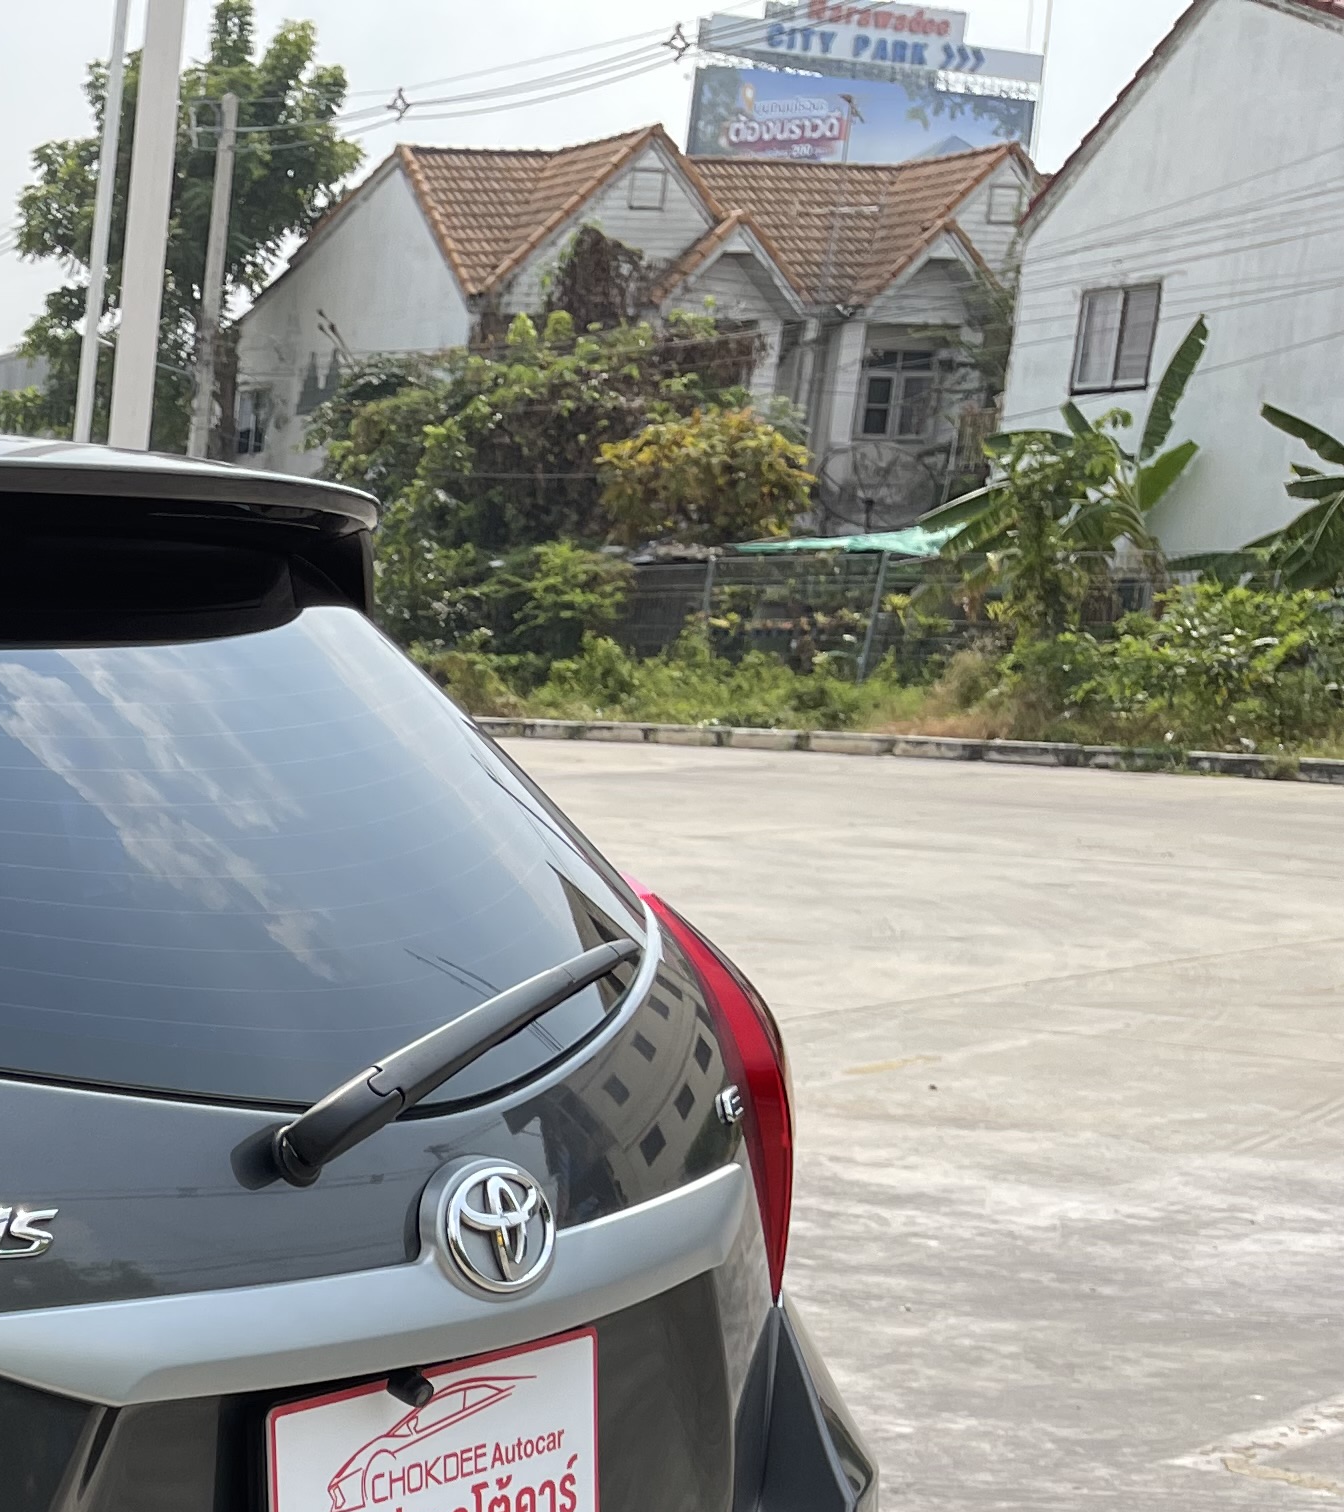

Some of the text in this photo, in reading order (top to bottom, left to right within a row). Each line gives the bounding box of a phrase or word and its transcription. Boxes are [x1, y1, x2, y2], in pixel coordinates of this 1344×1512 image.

[768, 23, 928, 66] CITY PARK
[371, 1429, 565, 1504] CHOKDEE Autocar
